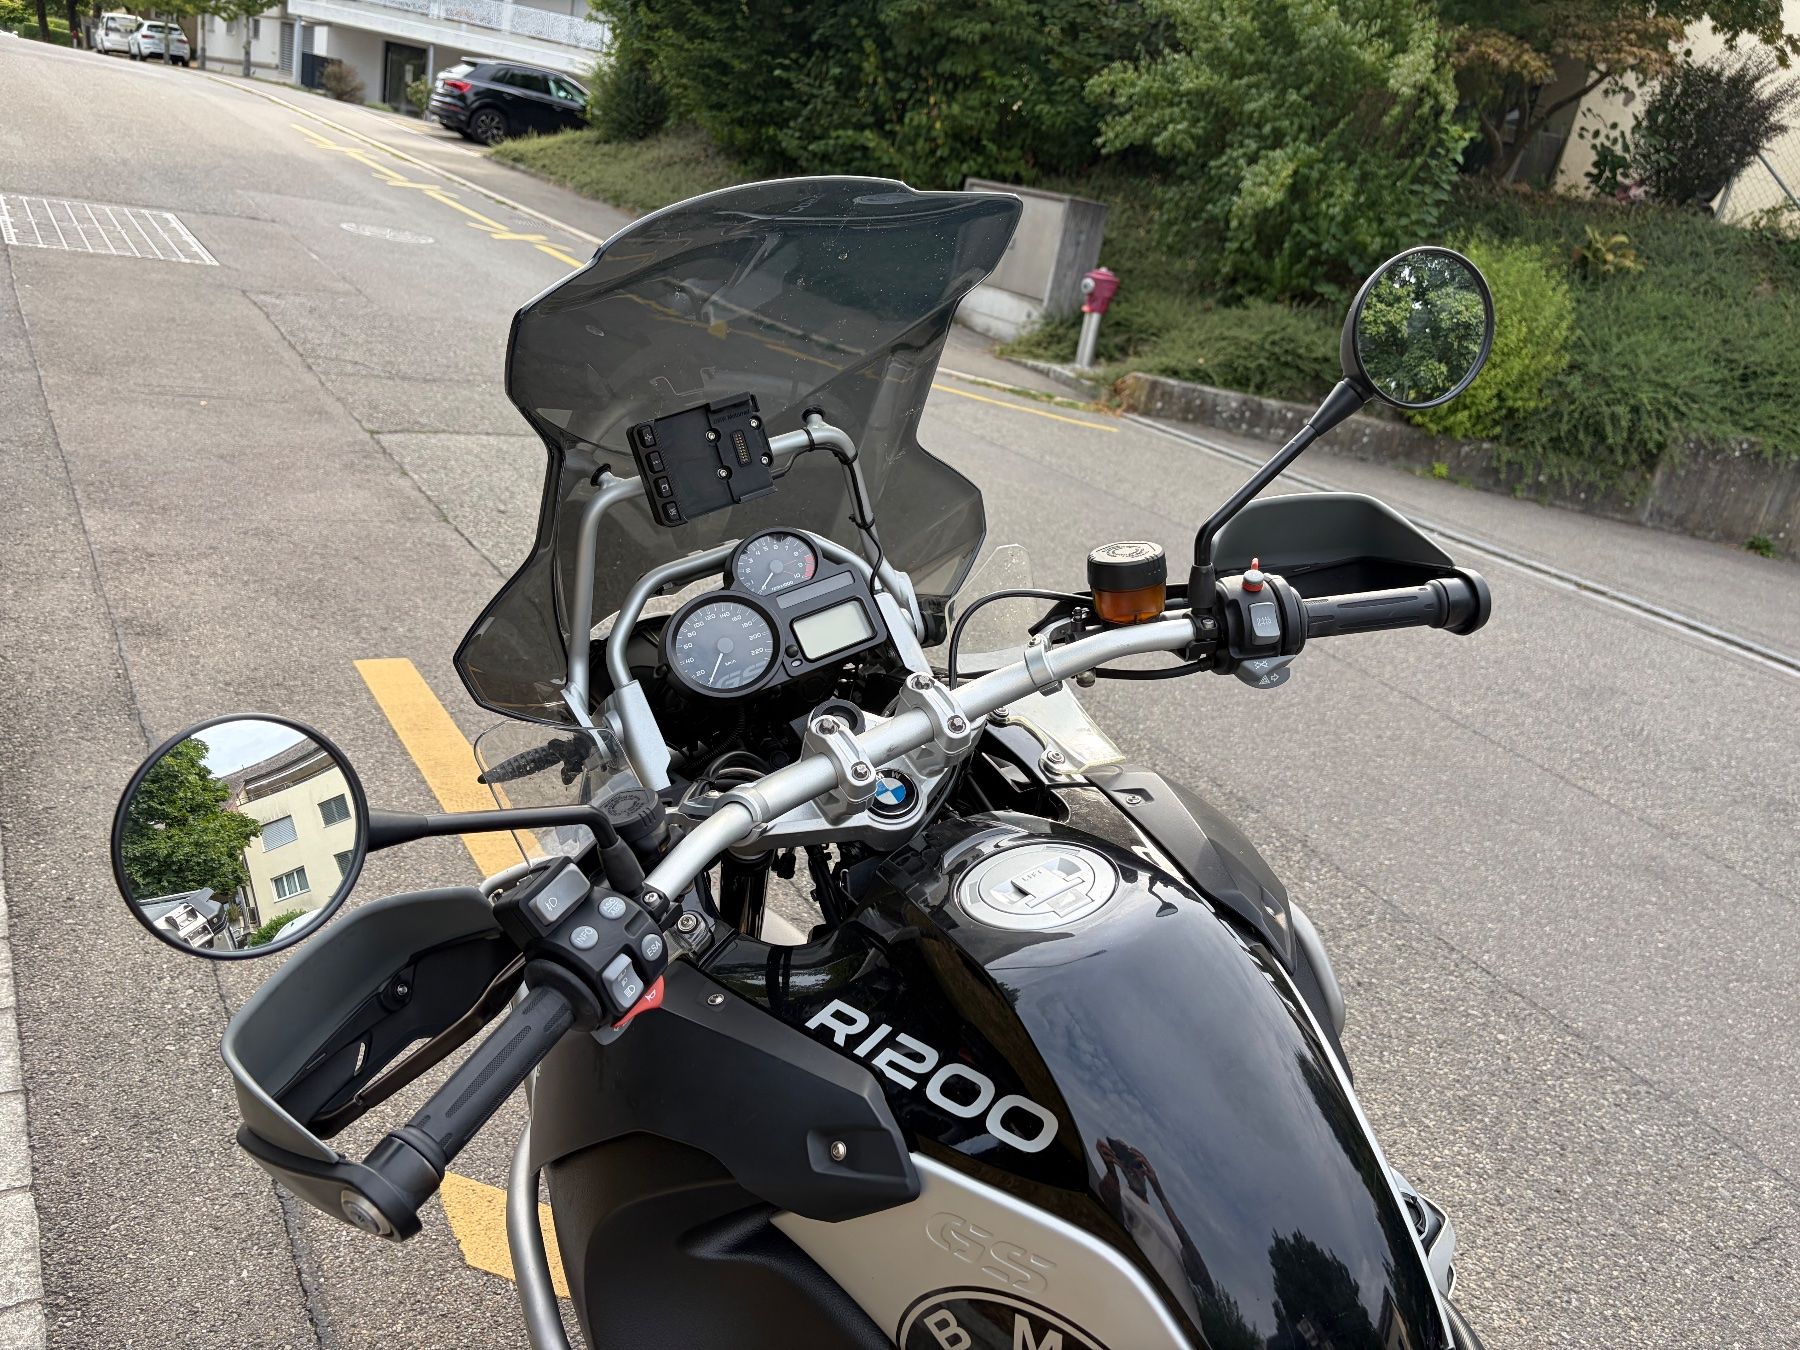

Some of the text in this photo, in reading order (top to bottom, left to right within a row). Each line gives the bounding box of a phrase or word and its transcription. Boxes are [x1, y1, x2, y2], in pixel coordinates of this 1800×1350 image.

[751, 648, 764, 656] 220
[576, 928, 593, 944] INFO
[647, 941, 660, 956] ESA
[804, 998, 1059, 1153] R1200
[925, 1211, 1057, 1294] GS
[924, 1308, 1062, 1350] BM
